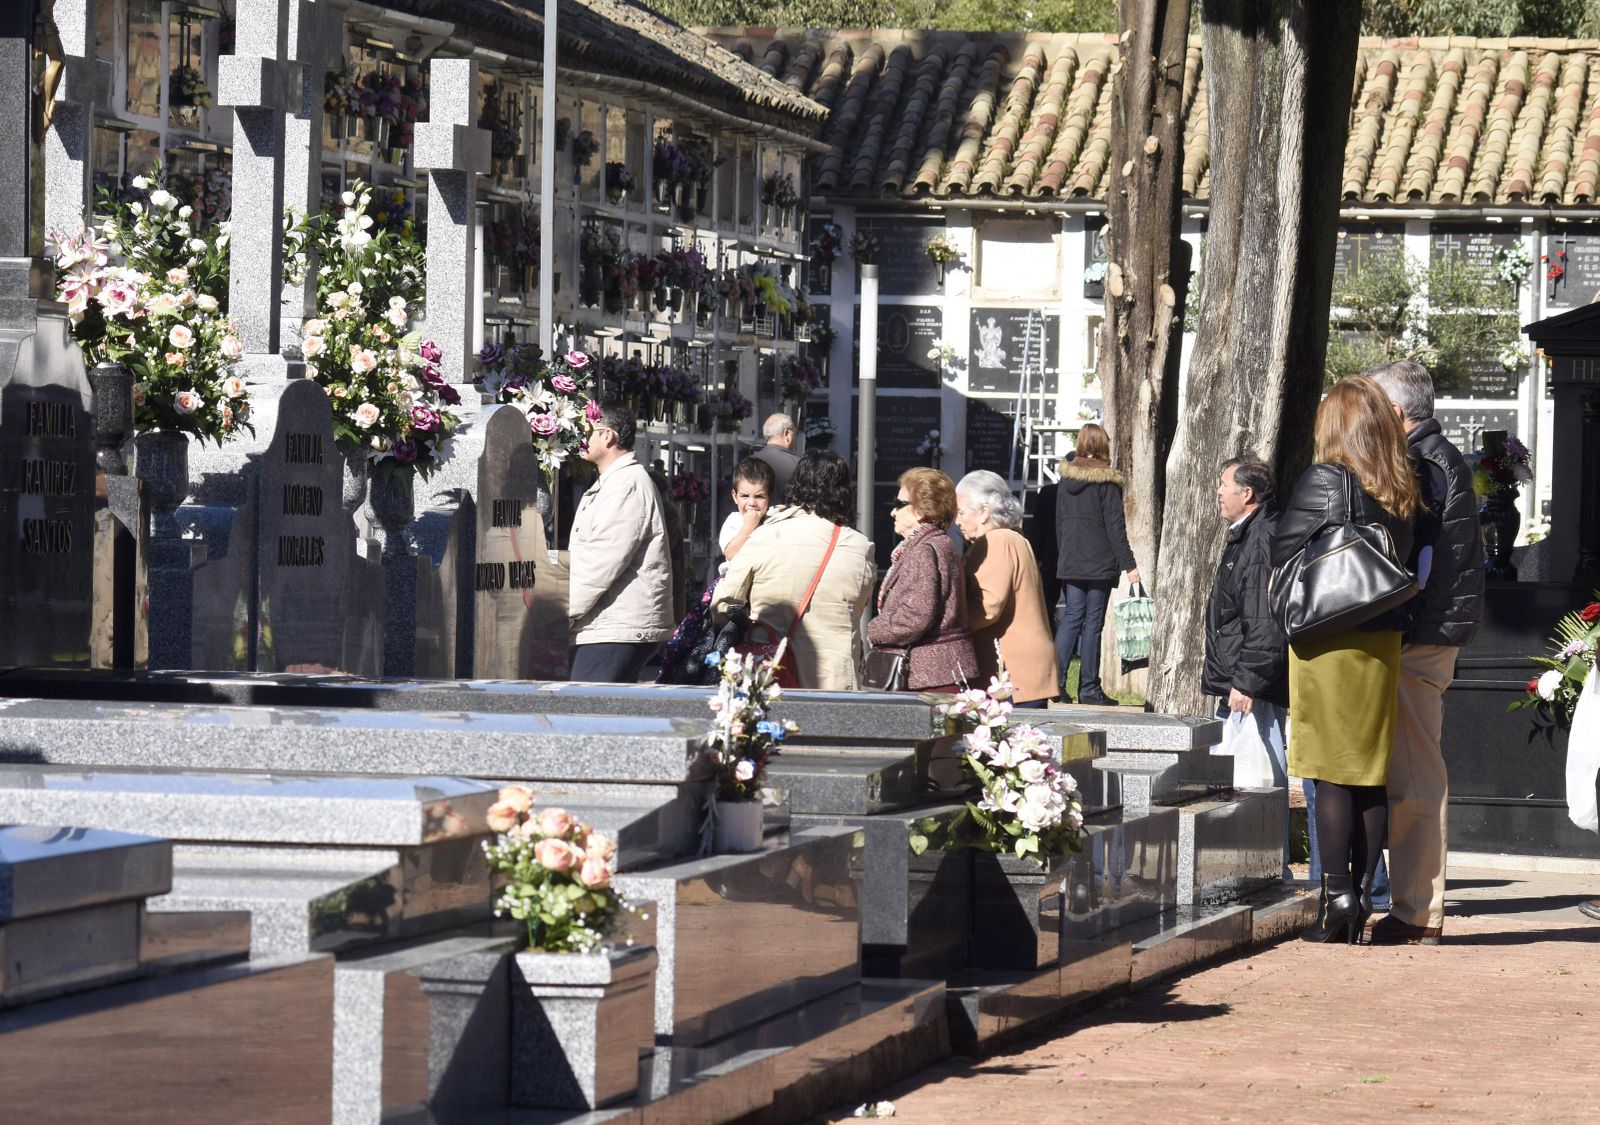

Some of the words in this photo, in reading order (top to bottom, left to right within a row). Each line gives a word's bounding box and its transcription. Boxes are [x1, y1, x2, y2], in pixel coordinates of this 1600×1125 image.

[26, 401, 76, 437] FAMILIA
[286, 432, 324, 465] FAMILIA
[22, 458, 77, 497] RAMIREZ
[283, 484, 323, 517] MORENO
[23, 518, 73, 553] SANTOS
[278, 535, 325, 568] MORALES
